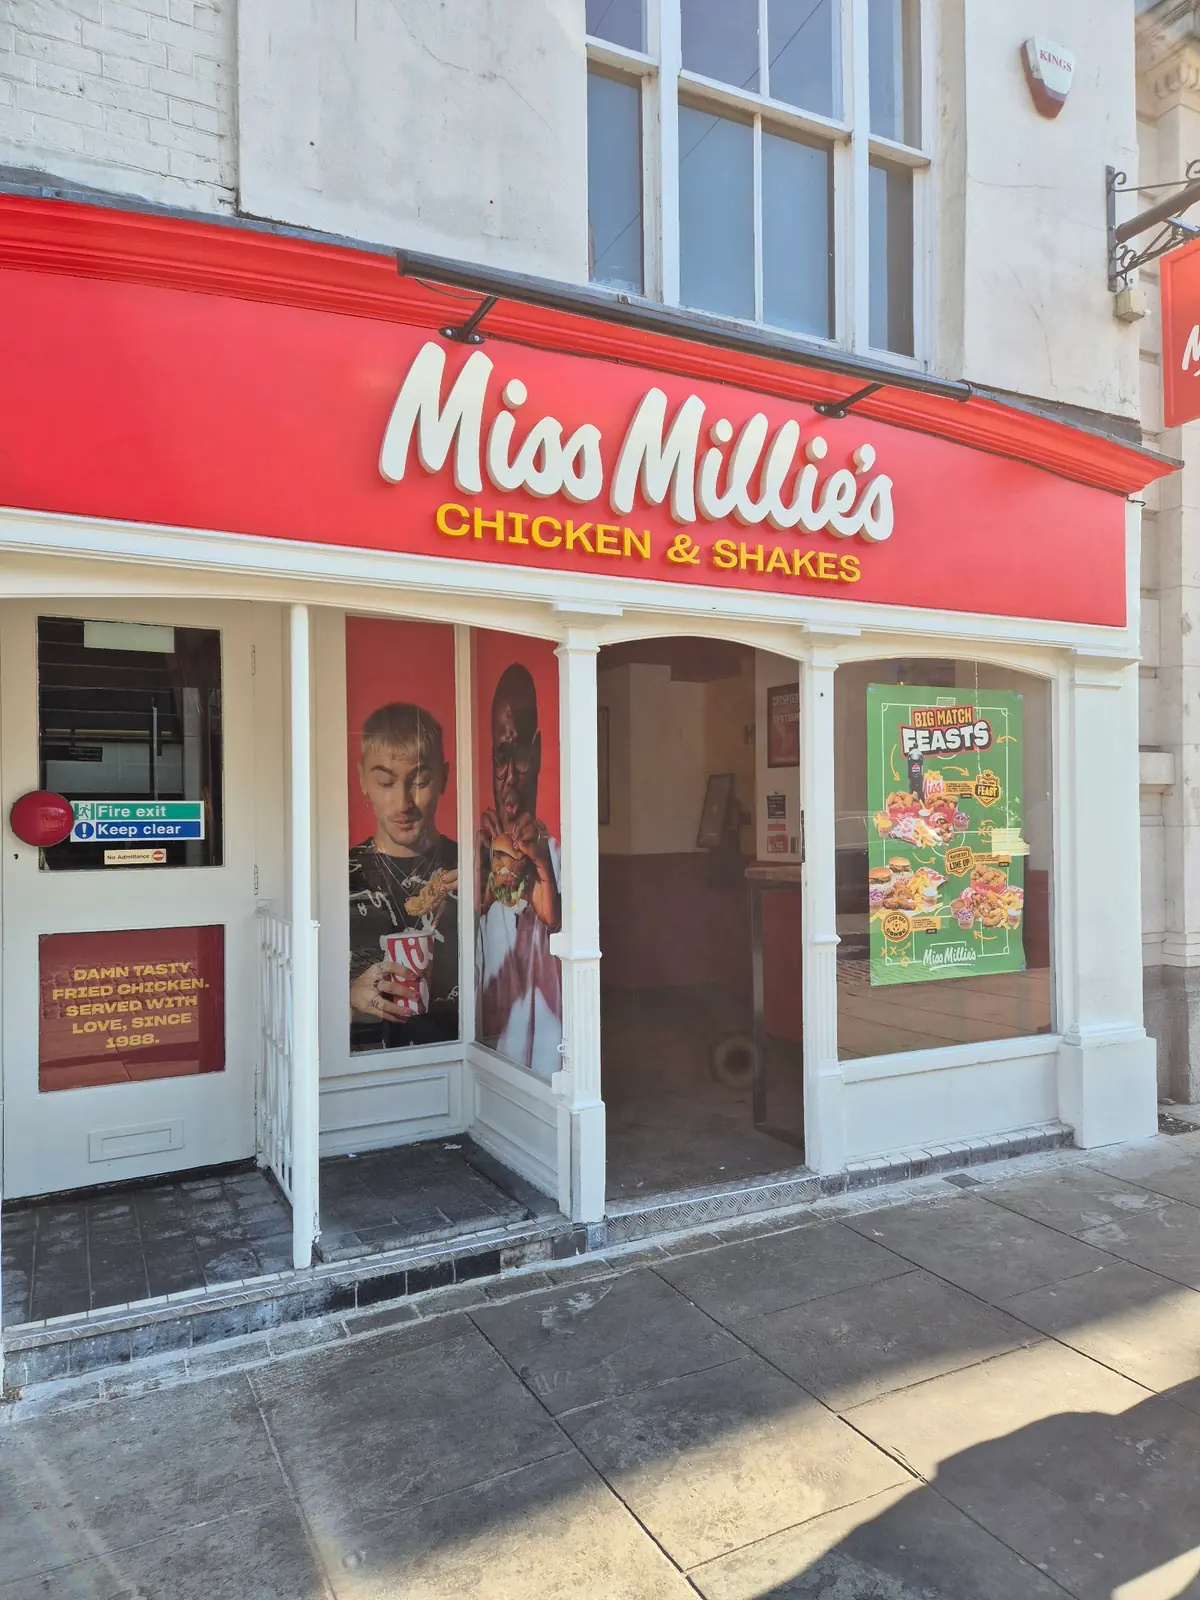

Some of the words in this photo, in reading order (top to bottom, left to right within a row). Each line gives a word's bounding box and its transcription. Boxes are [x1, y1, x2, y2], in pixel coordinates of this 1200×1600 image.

[1040, 49, 1072, 73] KINGS
[378, 341, 602, 503] Miss
[610, 387, 895, 542] Millie's
[435, 503, 651, 560] CHICKEN
[667, 533, 701, 565] &
[712, 539, 861, 583] SHAKES
[914, 711, 935, 728] BIG
[936, 708, 972, 727] MATCH
[902, 721, 990, 754] FEASTS
[977, 785, 998, 797] FEAST
[98, 805, 131, 817] Fire
[136, 805, 167, 817] exit
[97, 824, 138, 837] Keep
[143, 823, 181, 835] clear
[922, 949, 943, 966] Miss
[943, 945, 977, 964] Millie's
[73, 966, 129, 981] DAMN
[133, 962, 190, 976] TASTY
[52, 985, 113, 1000] FRIED
[117, 978, 210, 995] CHICKEN.
[65, 1000, 142, 1017] SERVED
[145, 995, 198, 1010] WITH
[72, 1019, 128, 1034] LOVE,
[131, 1013, 192, 1028] SINCE
[105, 1033, 160, 1048] 1988.
